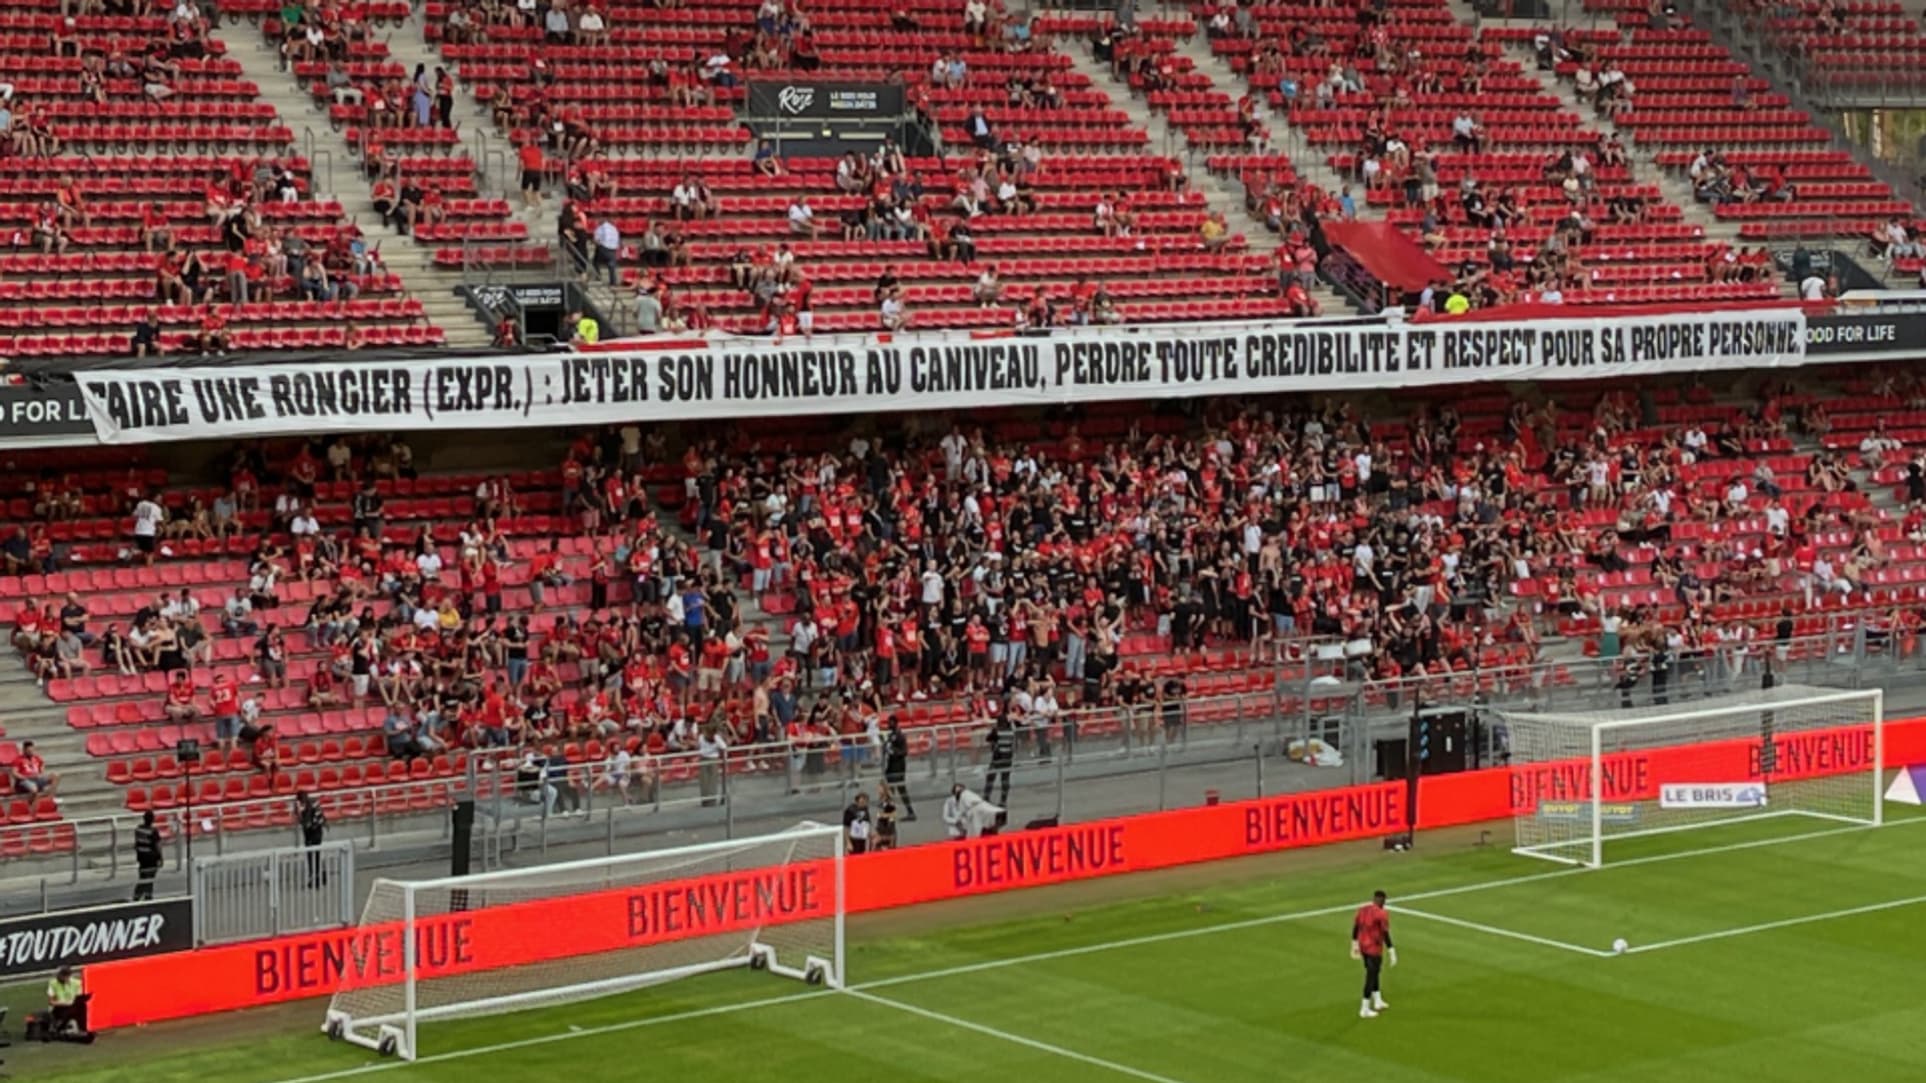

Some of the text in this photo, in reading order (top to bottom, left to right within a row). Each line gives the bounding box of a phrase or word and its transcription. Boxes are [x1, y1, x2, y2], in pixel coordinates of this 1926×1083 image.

[1806, 325, 1896, 343] OOD FOR LIFE
[191, 374, 265, 424] UNE
[269, 368, 412, 417] RONGIER
[423, 364, 532, 421] (EXPR.)
[561, 357, 649, 404] JETER
[658, 354, 713, 401] SON
[724, 350, 858, 399] HONNEUR
[866, 348, 900, 395] AU
[910, 344, 1046, 393] CANIVEAU,
[1054, 341, 1151, 386] PERDRE
[1155, 337, 1238, 383] TOUTE
[1245, 332, 1399, 378] CREDIBILITE
[1407, 330, 1436, 370] ET
[1444, 328, 1536, 369] RESPECT
[1541, 328, 1595, 367] POUR
[1601, 326, 1626, 363] SA
[1631, 322, 1704, 362] PROPRE
[11, 402, 62, 423] FOR
[1749, 730, 1874, 778] BENVENUE
[1246, 789, 1399, 844] BIENVENUE
[1664, 788, 1733, 801] LE BRIS
[953, 826, 1125, 888] BIENVENUE
[627, 869, 819, 937] BIENVENUE
